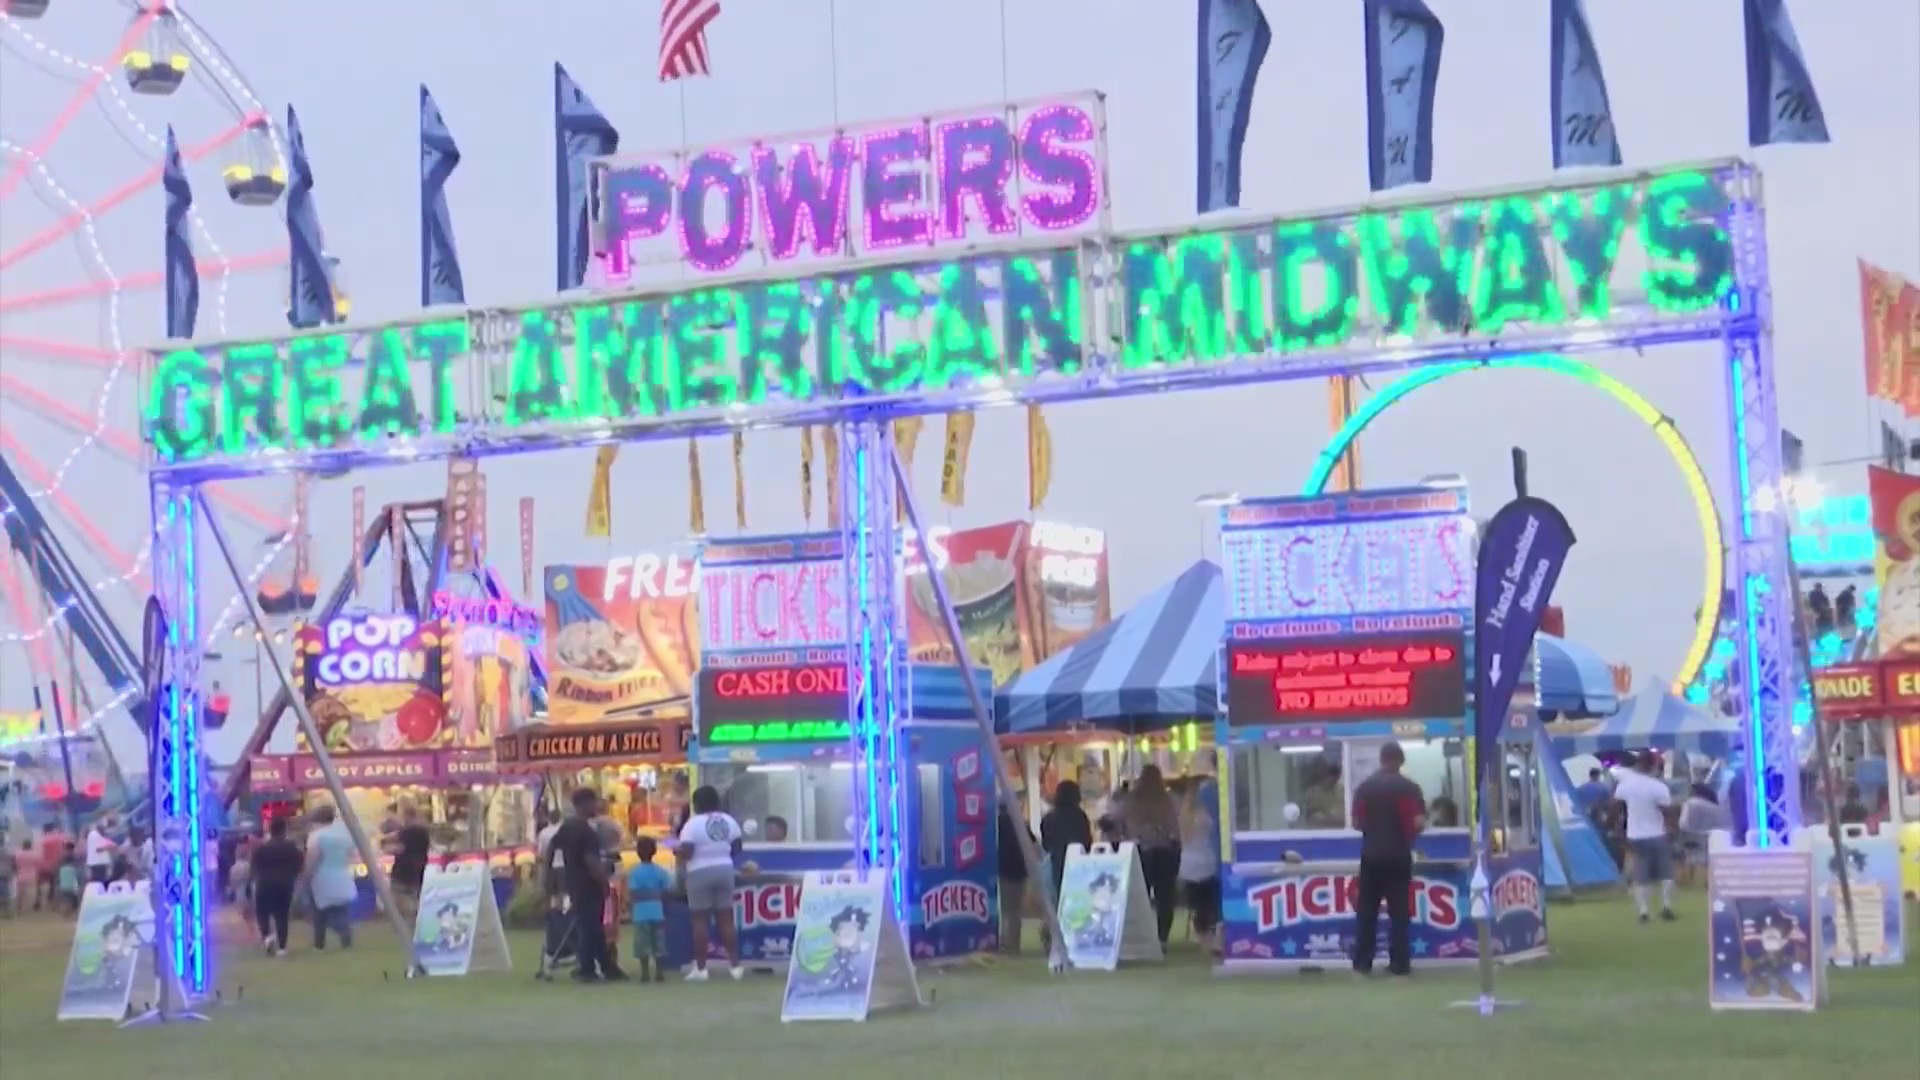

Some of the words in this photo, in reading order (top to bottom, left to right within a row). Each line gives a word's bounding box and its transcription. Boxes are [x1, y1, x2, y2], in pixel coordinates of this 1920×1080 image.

[602, 104, 1099, 281] POWERS
[149, 319, 468, 461] GREAT
[505, 248, 1080, 426] AMERICAN
[1120, 171, 1735, 369] MIDWAYS
[1226, 516, 1468, 616] TICKETS
[1519, 558, 1550, 612] Station
[703, 564, 845, 646] TICKE
[1485, 577, 1517, 628] Hand
[327, 616, 416, 649] POP
[318, 650, 425, 683] CORN
[716, 668, 790, 697] CASH
[795, 666, 860, 694] ONL
[1280, 691, 1311, 709] NO
[529, 736, 583, 757] CHICKEN
[587, 733, 605, 753] ON
[609, 733, 618, 753] A
[622, 730, 660, 751] STICK
[305, 766, 359, 780] CADY
[363, 763, 424, 778] APPLES
[923, 883, 989, 928] TICKETS
[1251, 874, 1459, 930] TICKTS
